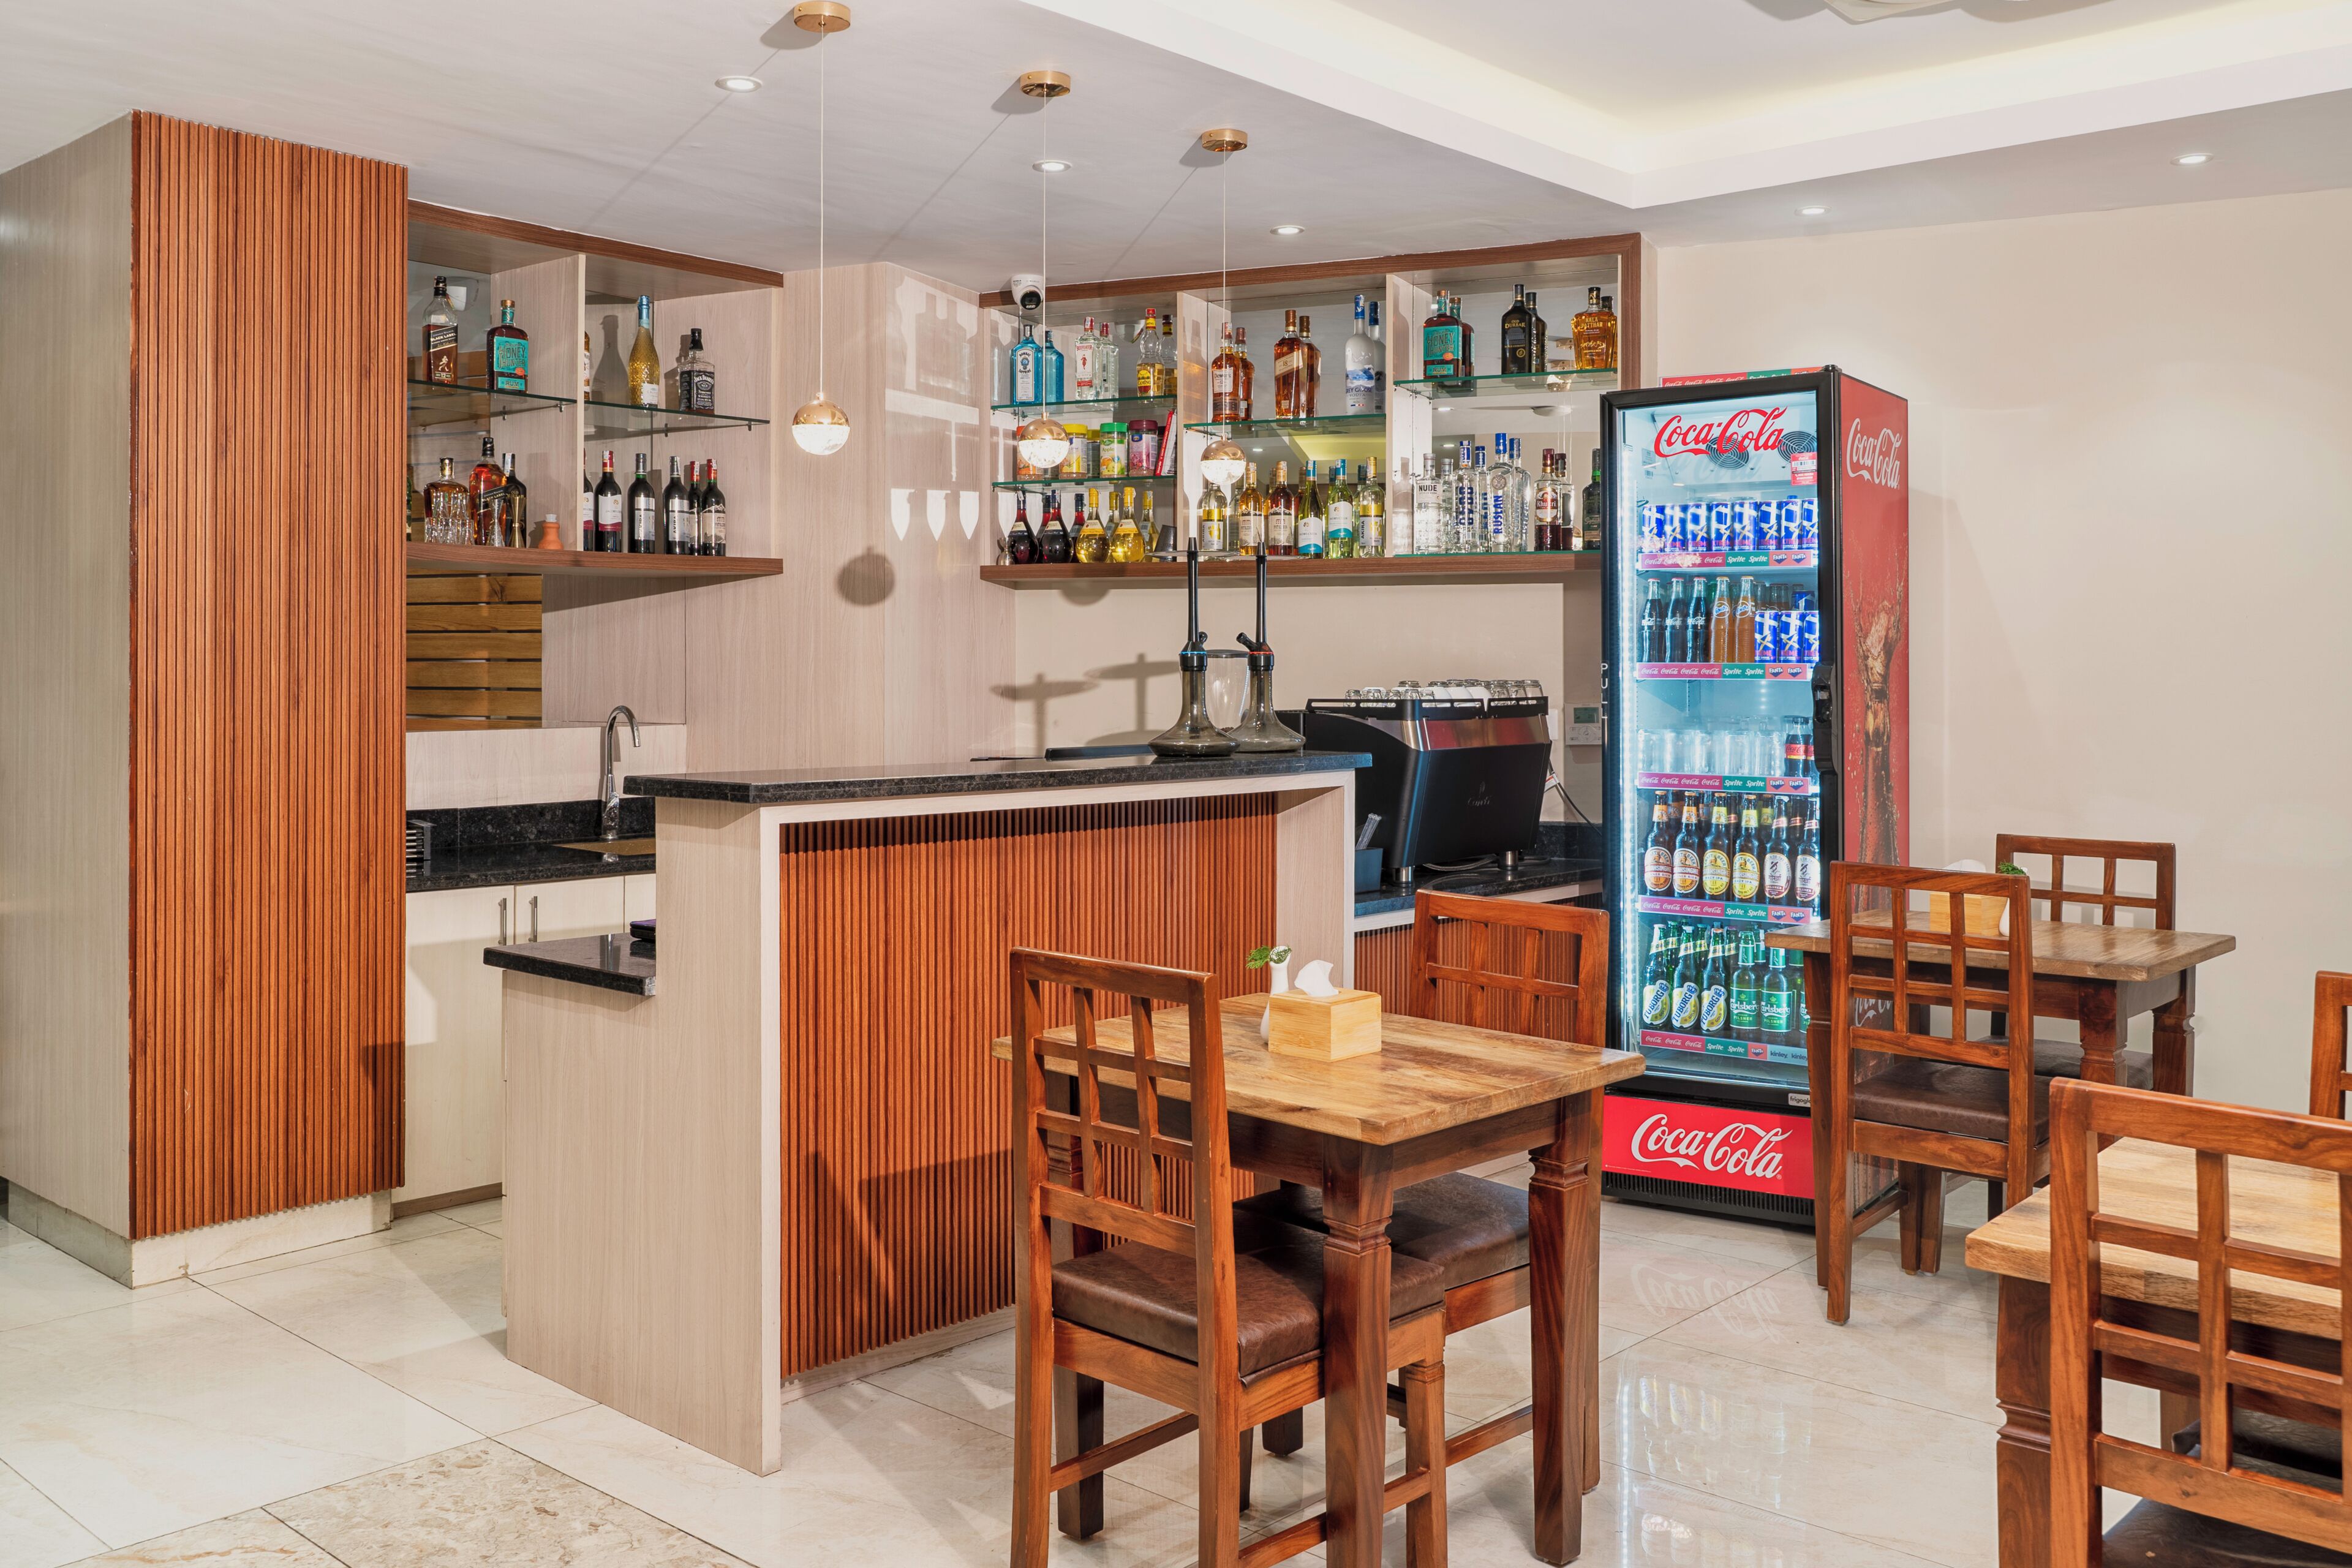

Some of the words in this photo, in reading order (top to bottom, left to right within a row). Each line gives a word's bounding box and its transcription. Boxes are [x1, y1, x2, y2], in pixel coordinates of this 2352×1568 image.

[1427, 333, 1455, 346] HONEY
[499, 345, 526, 358] HONEY
[1428, 344, 1453, 356] HUNTER
[500, 358, 526, 368] HUNTER
[1654, 406, 1788, 458] Coca-Cola
[1846, 418, 1902, 489] Coca-Cola
[1493, 496, 1502, 533] RUSLAN
[1660, 852, 1669, 863] BEER
[1687, 852, 1696, 865] BEER
[1717, 854, 1726, 866] BEER
[1746, 858, 1755, 869] BEER
[1644, 990, 1664, 1019] TUBORG
[1673, 992, 1692, 1022] TUBORG
[1701, 995, 1720, 1025] TUBORG
[1760, 1001, 1790, 1016] Carlsberg
[1770, 1050, 1787, 1059] kinley
[1630, 1114, 1793, 1178] Coca-Cola
